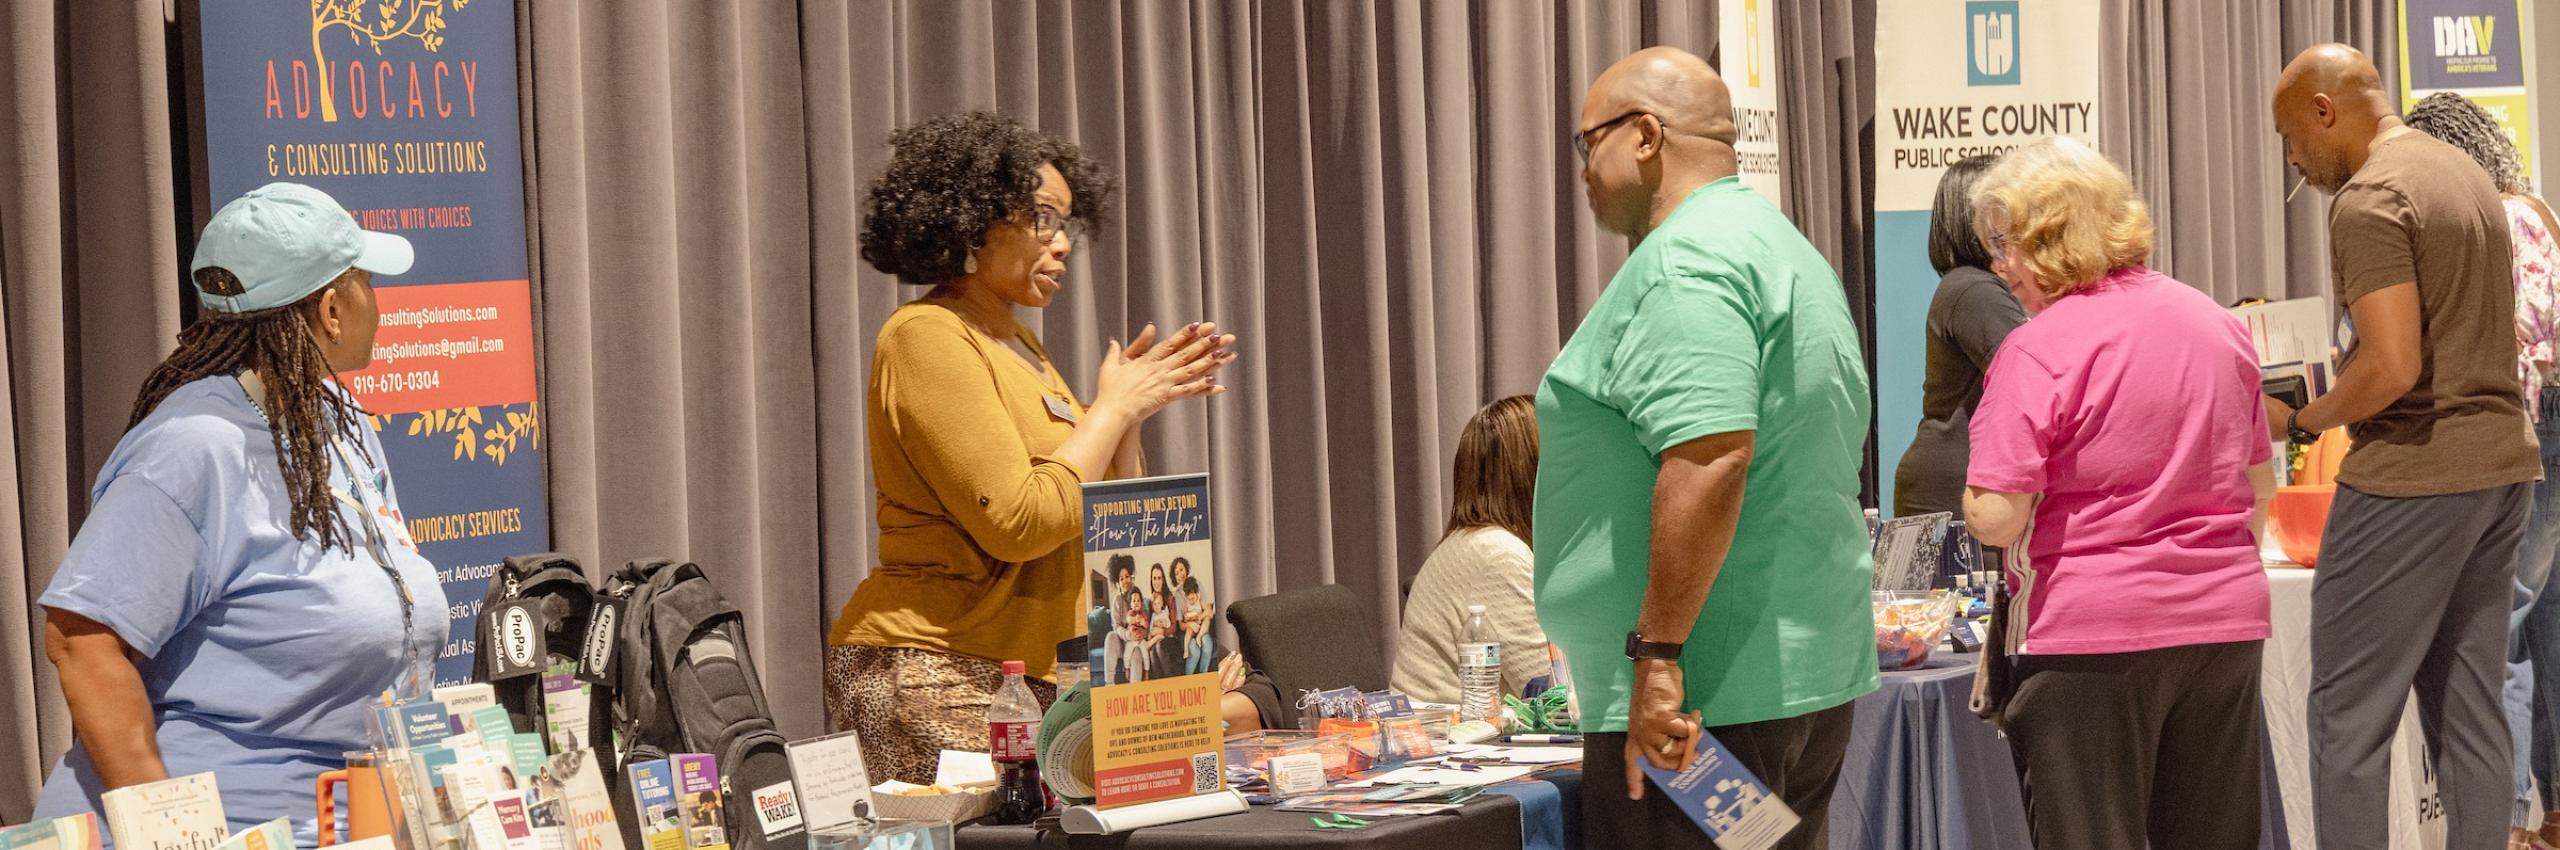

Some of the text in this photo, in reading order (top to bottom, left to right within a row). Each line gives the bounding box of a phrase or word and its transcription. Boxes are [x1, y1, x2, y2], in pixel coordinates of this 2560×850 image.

[2433, 16, 2495, 56] DAV
[265, 60, 477, 119] ADVOCACY
[1893, 102, 2091, 140] WAKE COUNTY
[267, 141, 487, 177] & CONSULTING SOLUTIONS
[1894, 148, 1953, 169] PUBLIC
[362, 208, 398, 230] VOICES
[400, 207, 426, 230] WITH
[428, 206, 472, 229] CHOICES
[378, 305, 497, 329] nsultingSolutions.com
[372, 337, 504, 364] tingSolutions@gmail.com
[353, 370, 440, 395] 919-670-0304
[1093, 494, 1198, 517] SUPPORTING MOMS BEYOND
[409, 507, 522, 544] ADVOCACY SERVICES
[1137, 511, 1160, 547] the
[511, 613, 526, 660] ProPac
[594, 613, 611, 667] ProPac
[1105, 686, 1207, 718] HOW ARE YOU, MOM?
[758, 791, 788, 810] Ready
[764, 796, 796, 823] WAKE!
[2419, 792, 2445, 825] PUB
